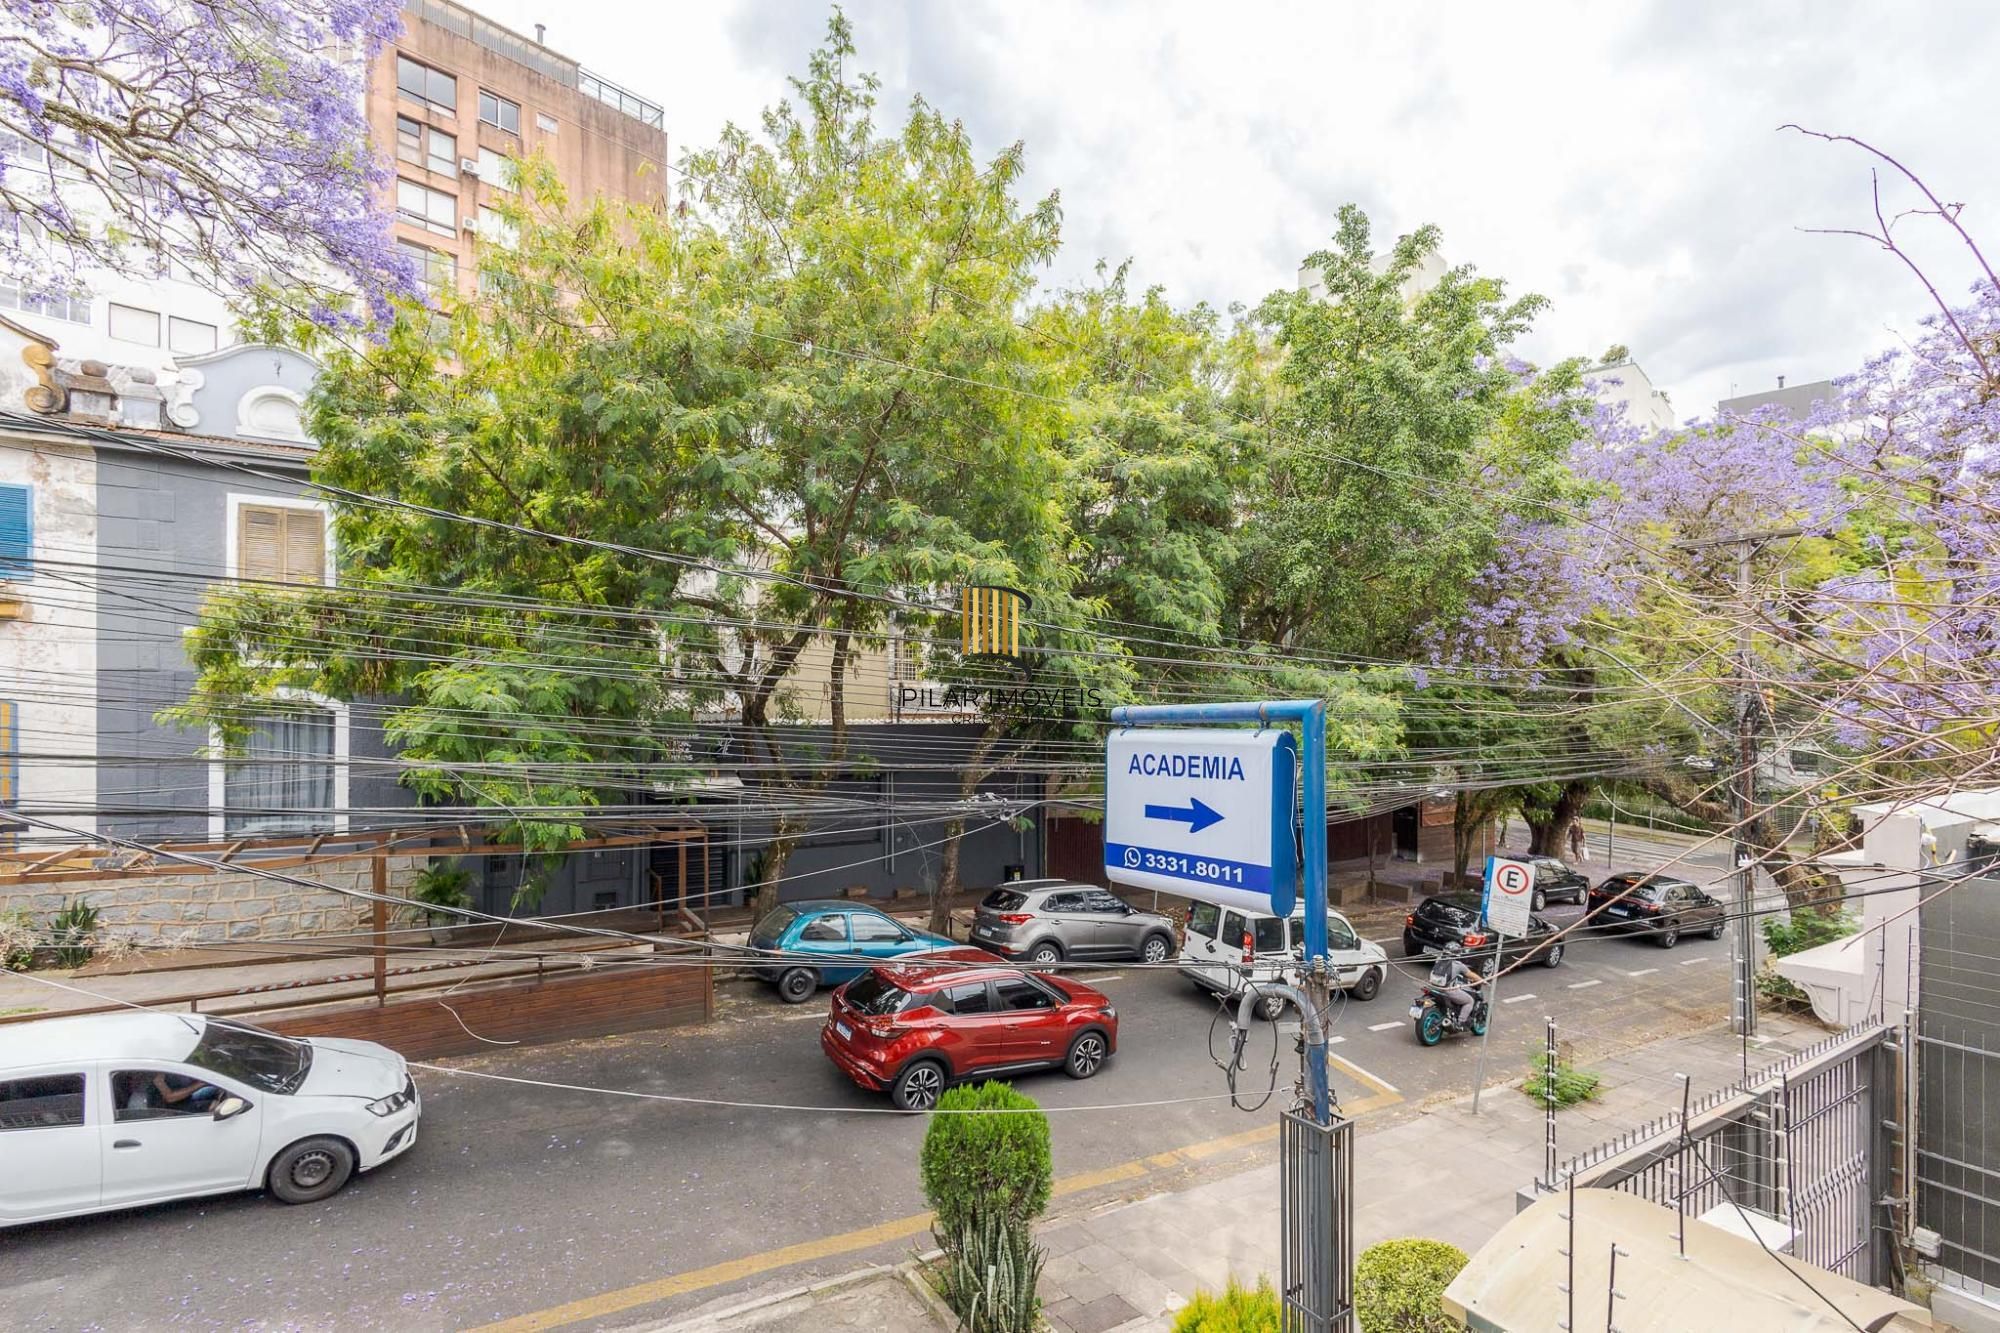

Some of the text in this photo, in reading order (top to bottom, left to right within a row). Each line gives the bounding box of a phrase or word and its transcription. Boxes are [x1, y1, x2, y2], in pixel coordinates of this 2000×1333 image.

[1128, 753, 1245, 781] ACADEMIA
[1145, 853, 1243, 883] 3331.8011
[1506, 870, 1519, 888] E
